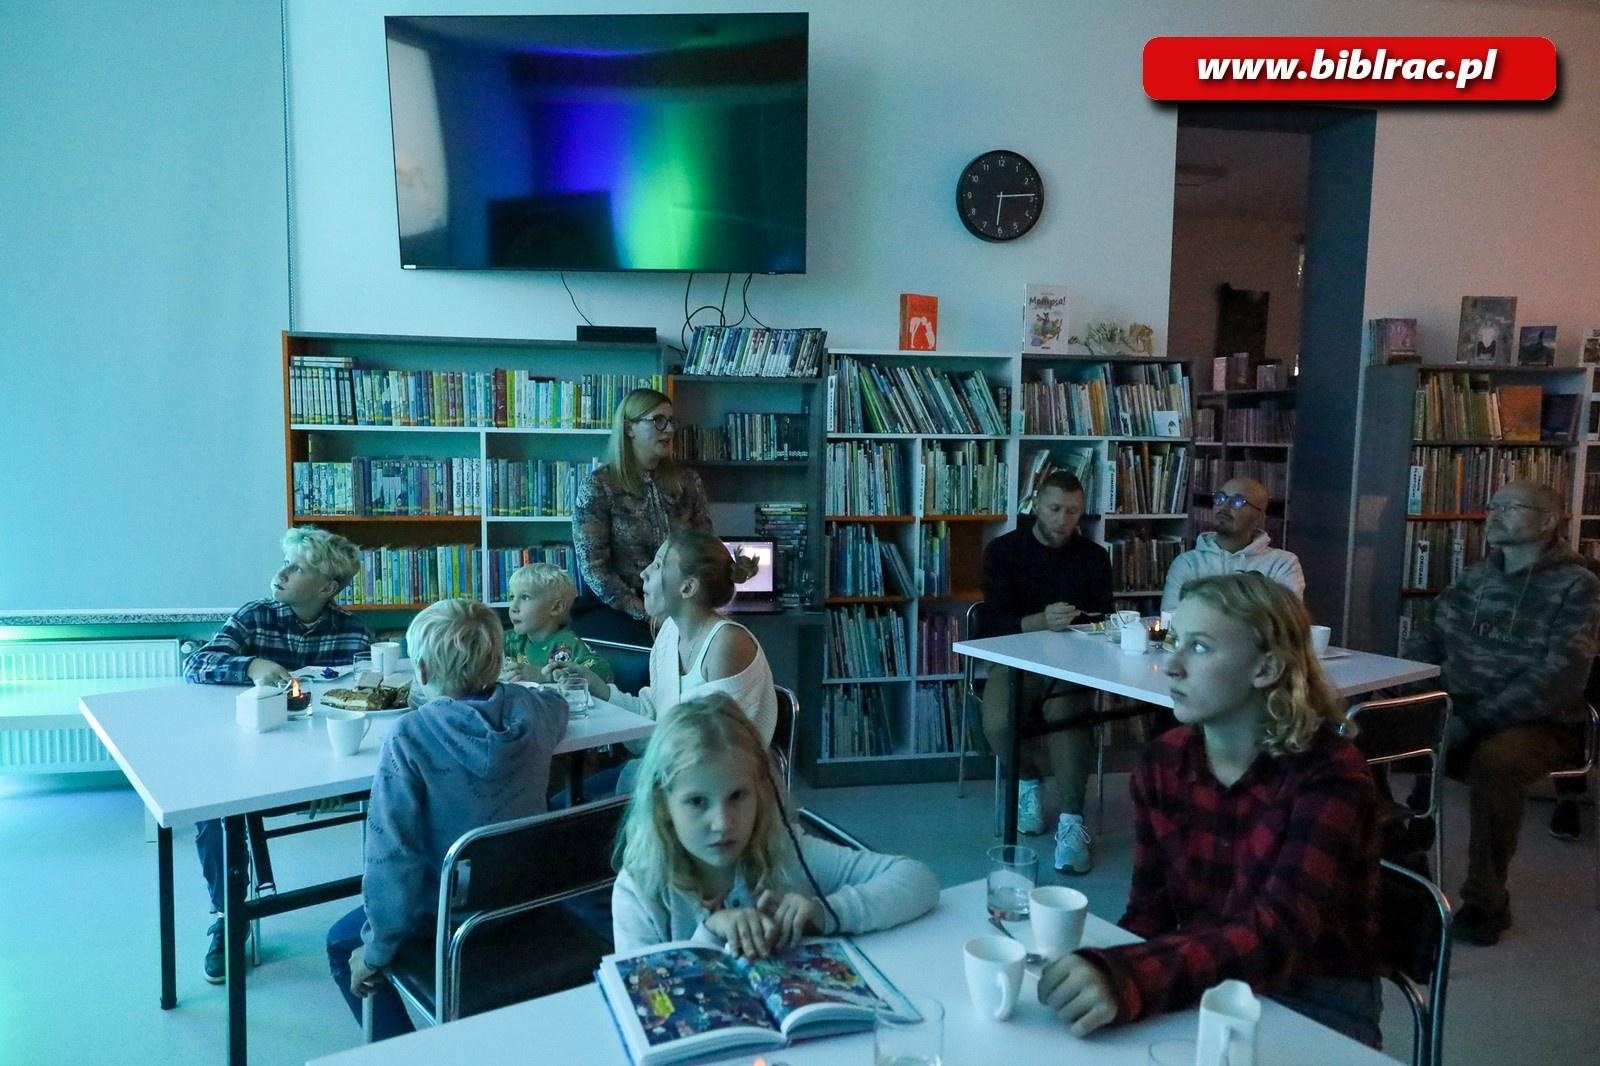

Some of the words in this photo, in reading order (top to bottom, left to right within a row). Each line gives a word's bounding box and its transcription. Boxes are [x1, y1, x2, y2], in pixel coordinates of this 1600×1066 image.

[972, 175, 979, 183] 10
[1024, 177, 1029, 185] 2
[967, 191, 972, 199] 9
[998, 226, 1003, 234] 6
[1013, 222, 1018, 230] 5
